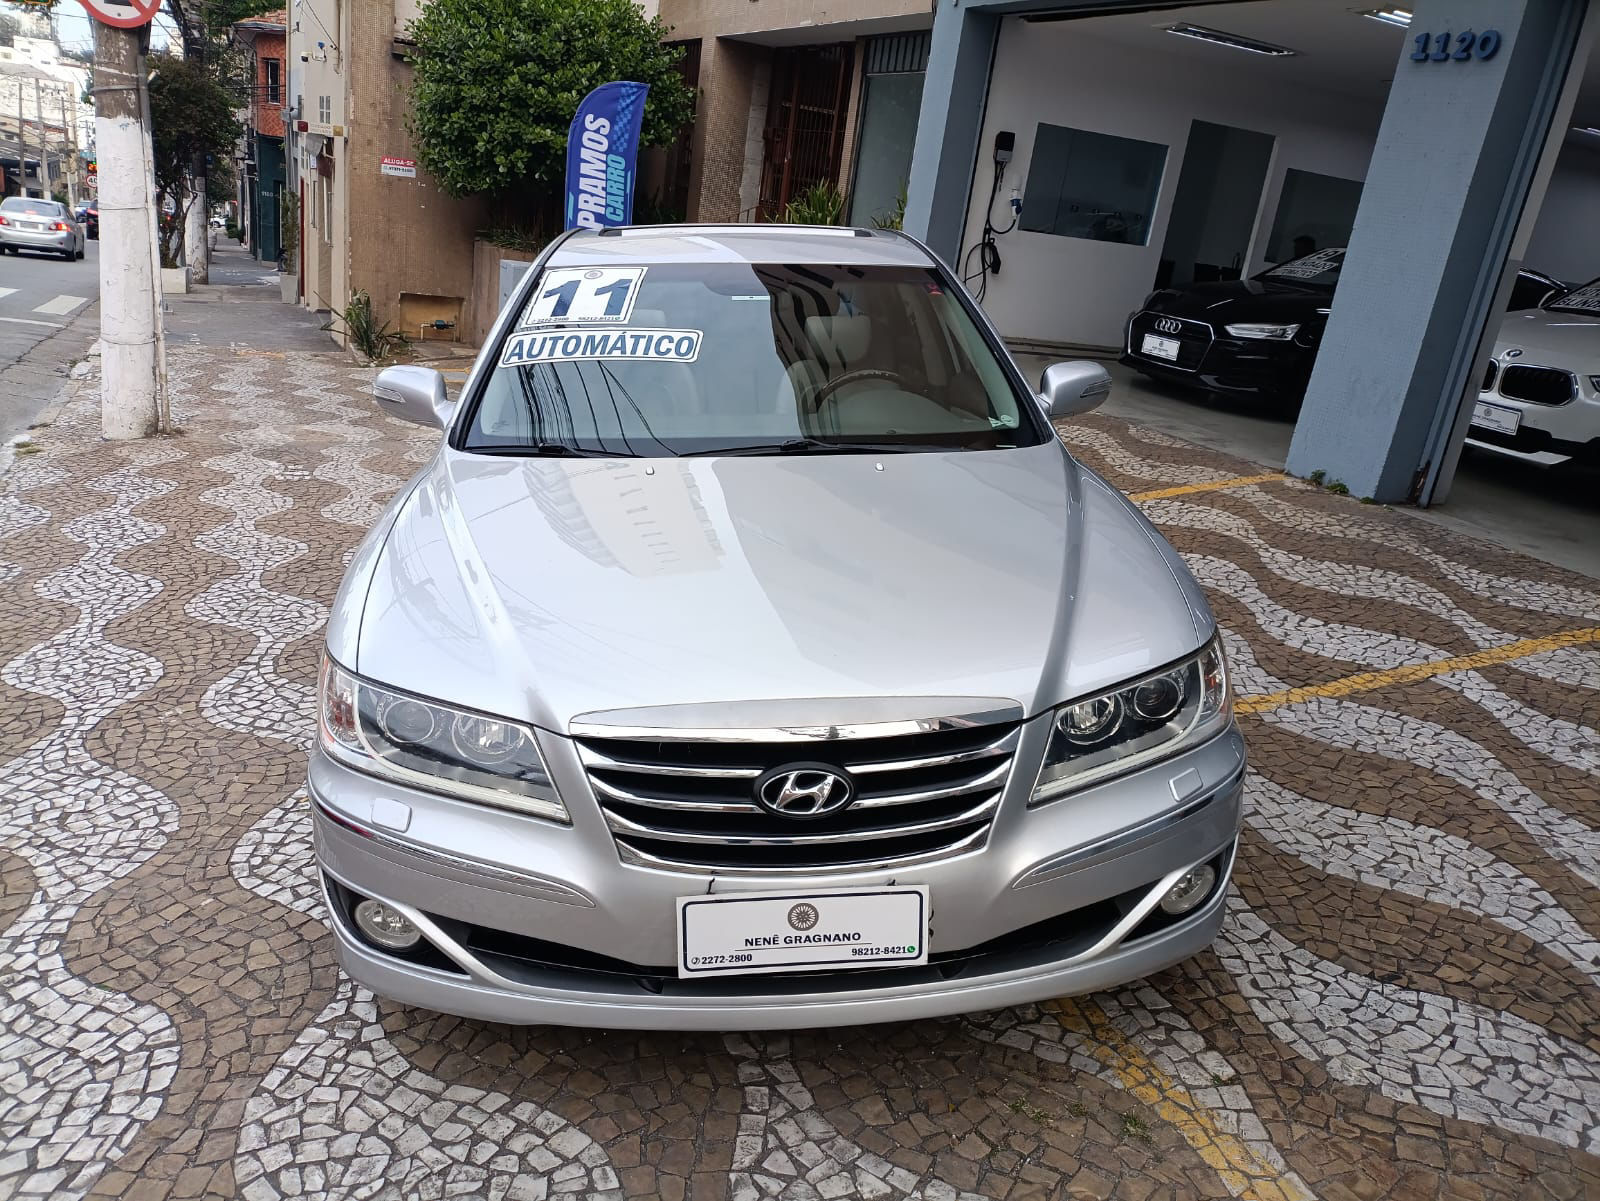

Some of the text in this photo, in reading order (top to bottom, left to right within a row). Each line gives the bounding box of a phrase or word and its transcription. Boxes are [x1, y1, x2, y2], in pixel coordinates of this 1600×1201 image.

[1410, 29, 1502, 62] 1120
[605, 153, 626, 222] CARRO
[542, 278, 633, 317] 11
[504, 331, 695, 363] AUTOMÁTICO
[744, 932, 862, 947] NENÊ GRAGNANO
[851, 946, 907, 957] 98212-8421
[701, 953, 753, 965] 2272-2800
